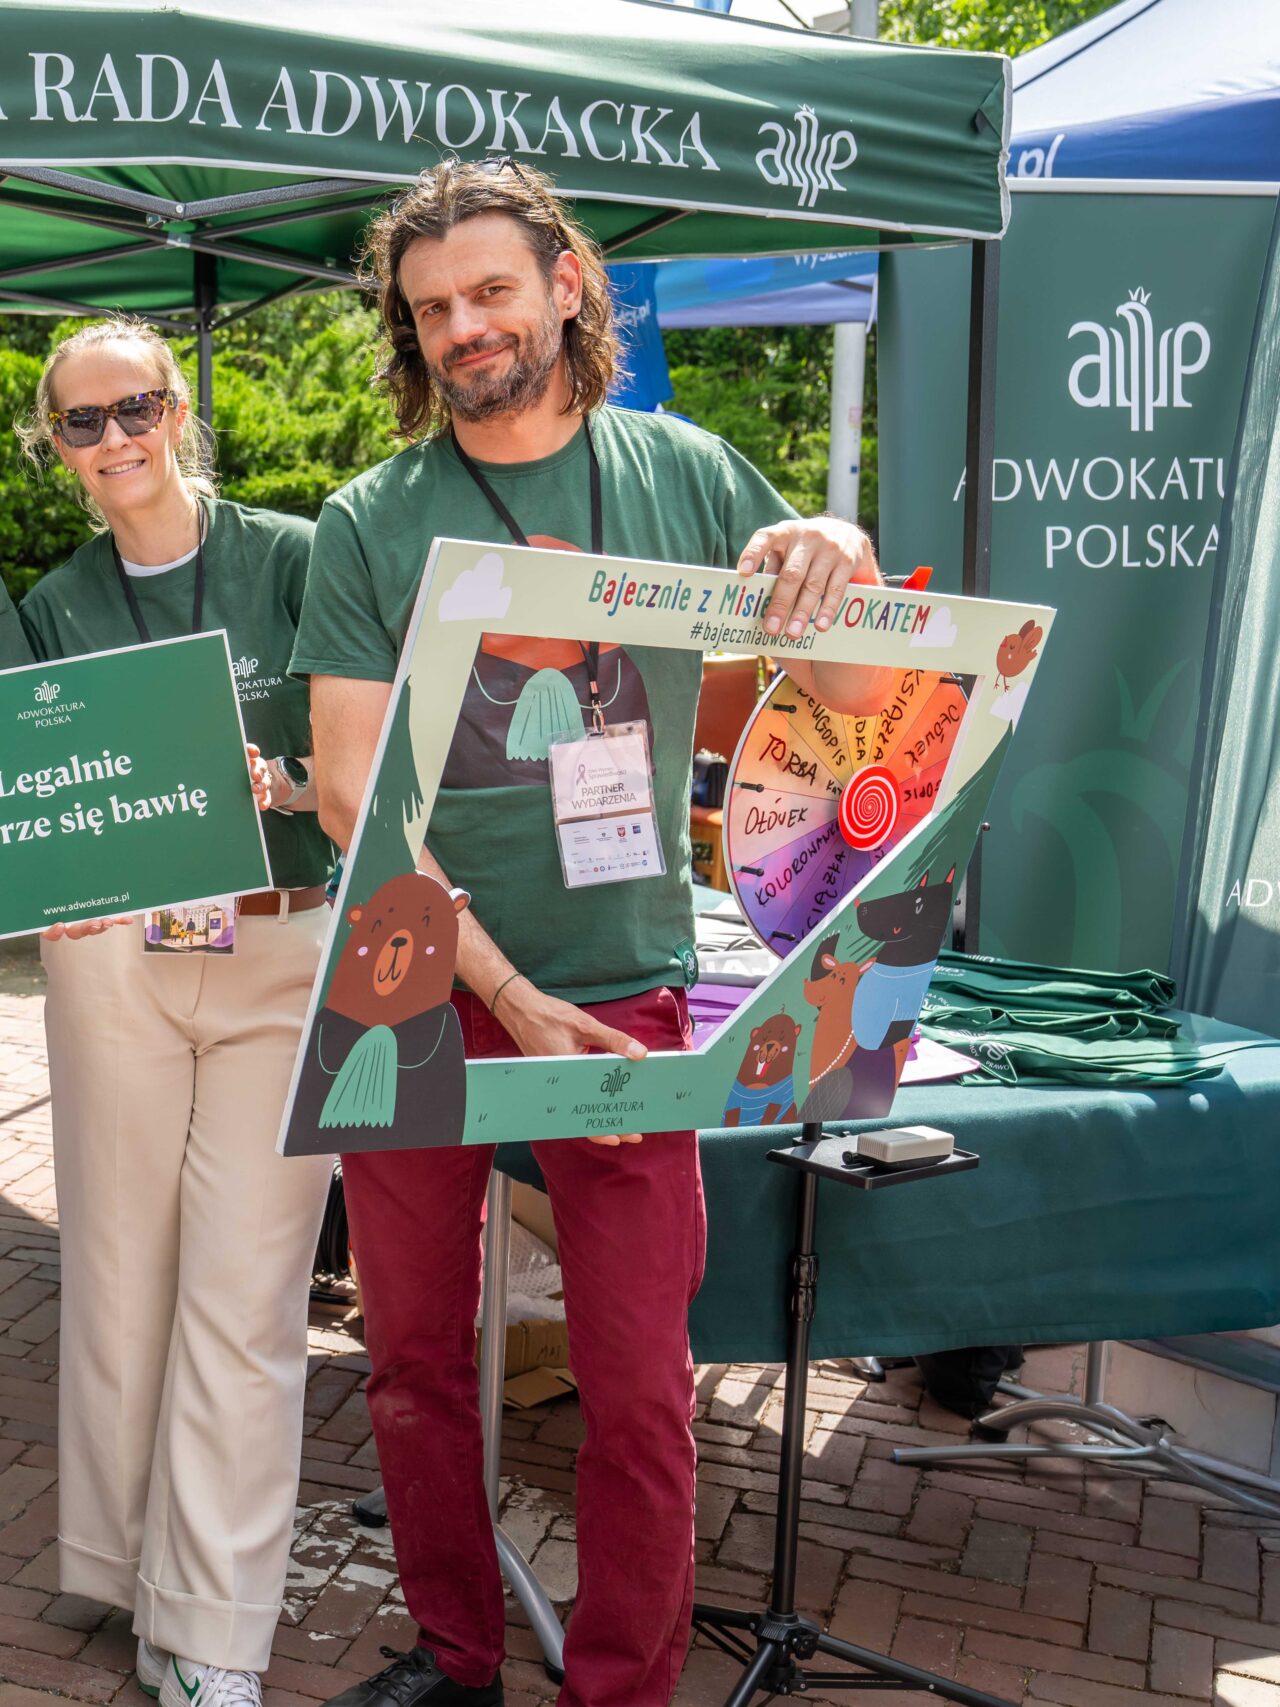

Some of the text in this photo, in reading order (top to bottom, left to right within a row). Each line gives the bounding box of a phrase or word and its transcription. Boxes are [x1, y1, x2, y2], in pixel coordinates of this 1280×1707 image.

[29, 52, 243, 129] RADA
[257, 66, 721, 172] ADWOKACKA
[1045, 523, 1219, 568] POLSKA
[588, 569, 692, 617] Bajecznie
[696, 589, 713, 614] z
[718, 583, 772, 619] Misie
[236, 676, 283, 691] OKATURA
[238, 690, 270, 702] OLSKA
[17, 701, 86, 720] ADWOKATURA
[35, 715, 72, 728] POLSKA
[759, 733, 818, 786] TORBA
[581, 783, 625, 797] PARTNER
[60, 802, 104, 835] się
[111, 783, 208, 825] bawię
[571, 792, 637, 810] WYDARZENIA
[43, 892, 131, 916] www.adwokatura.pl
[986, 1060, 1009, 1070] PRAWO
[571, 1101, 644, 1115] ADWOKATURA
[585, 1117, 623, 1129] POLSKA
